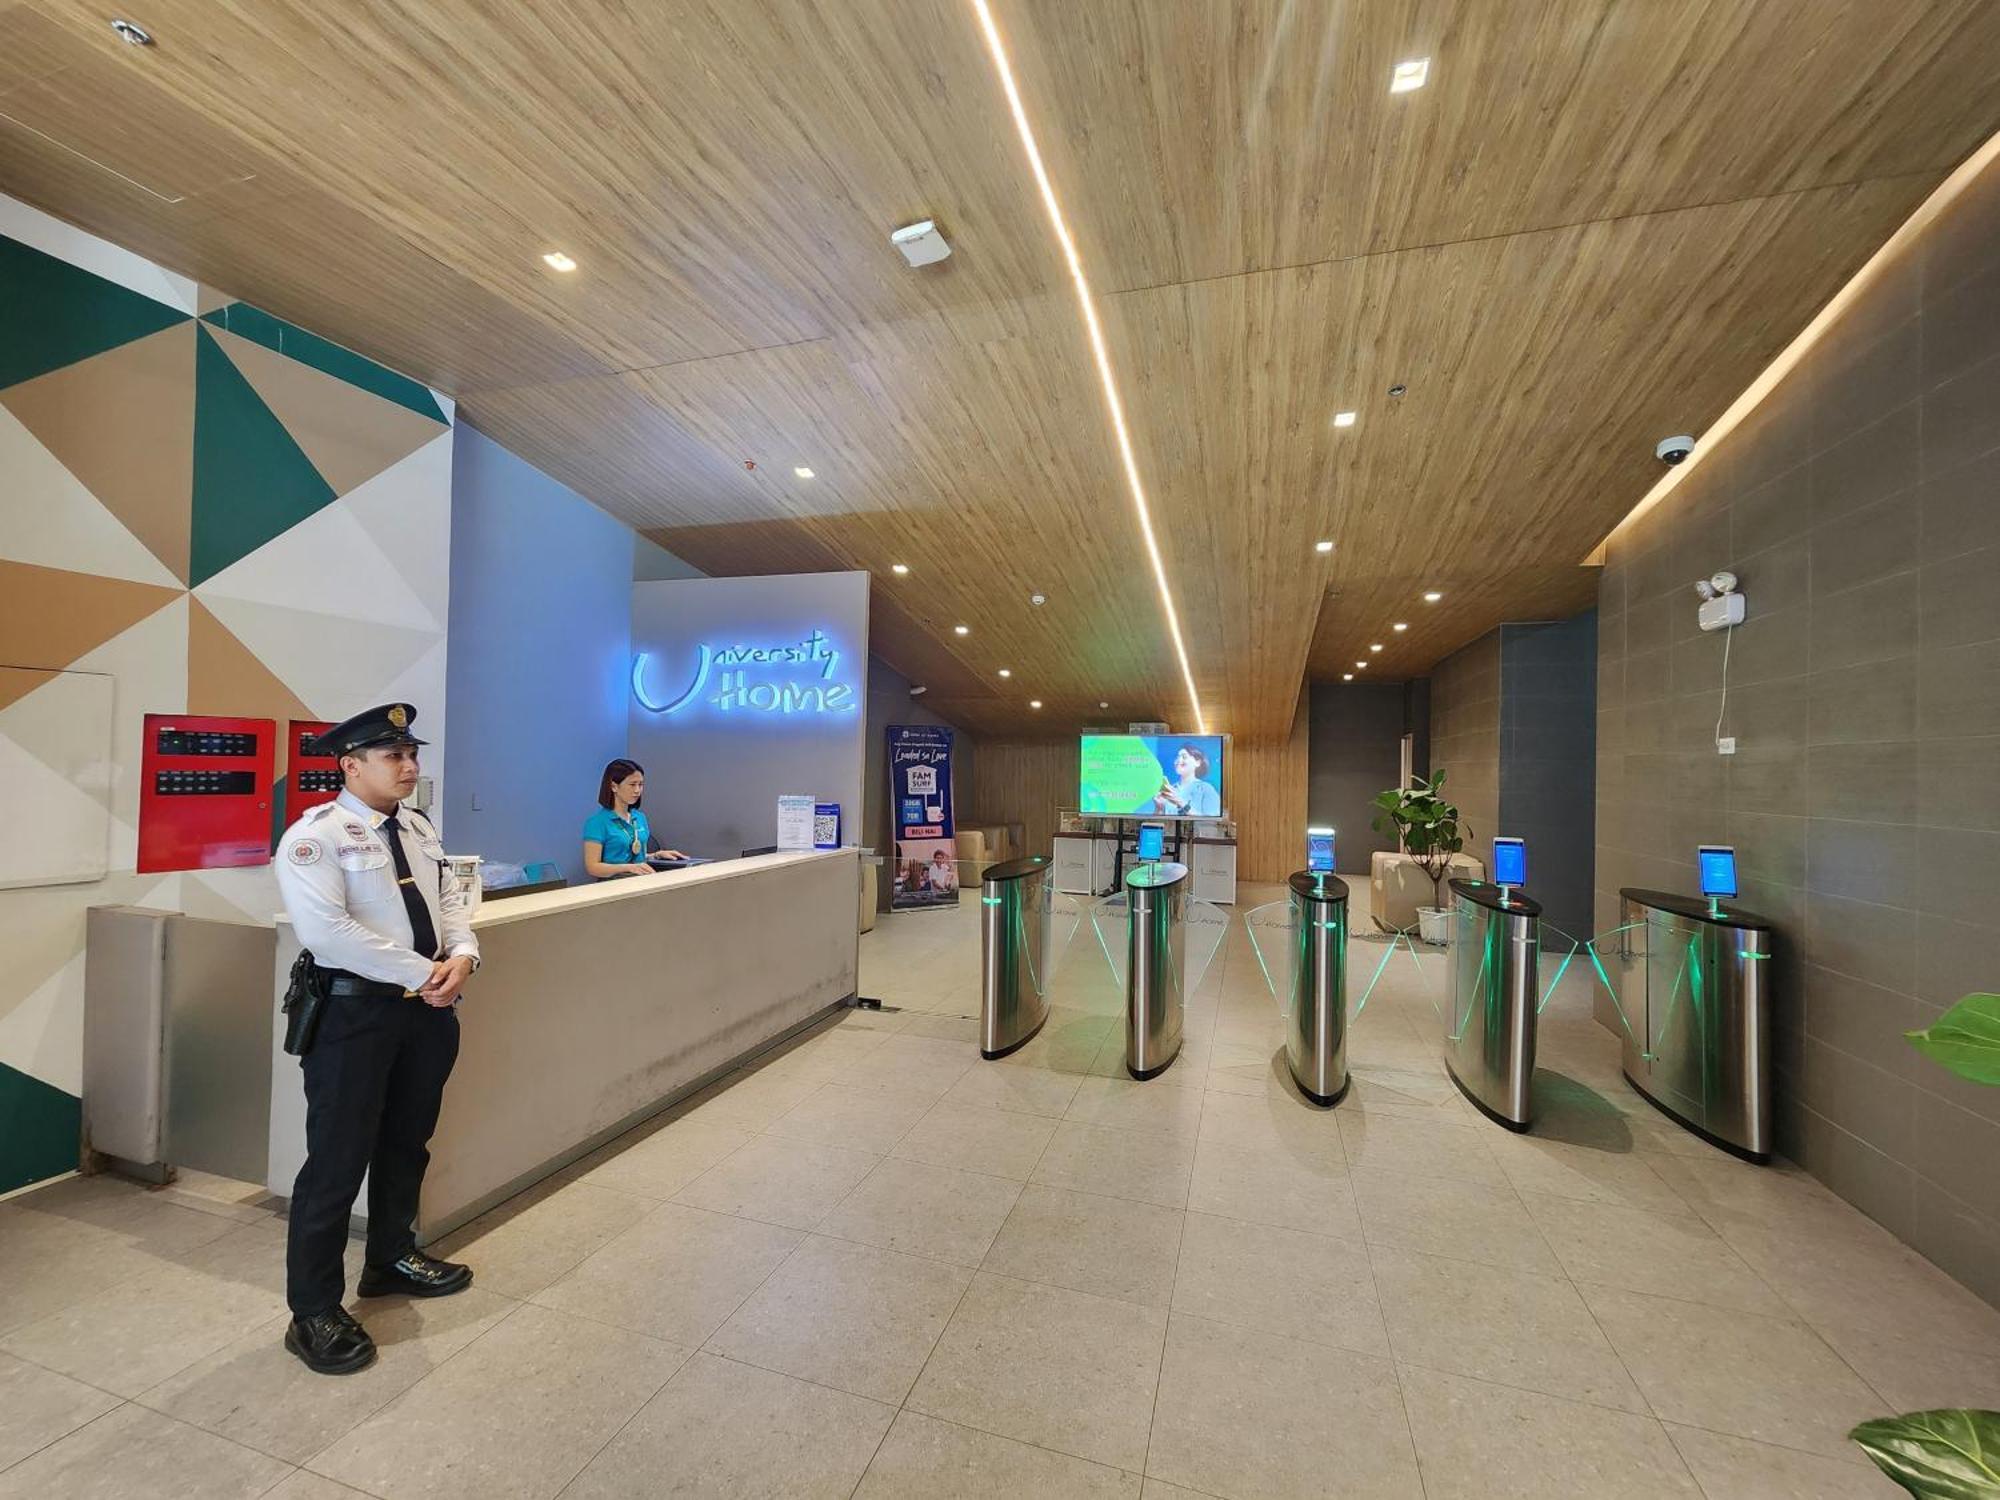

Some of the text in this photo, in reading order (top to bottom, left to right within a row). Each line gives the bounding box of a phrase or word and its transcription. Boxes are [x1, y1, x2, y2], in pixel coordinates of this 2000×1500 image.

[631, 629, 839, 713] University
[711, 670, 855, 713] Home
[912, 772, 931, 780] FAM
